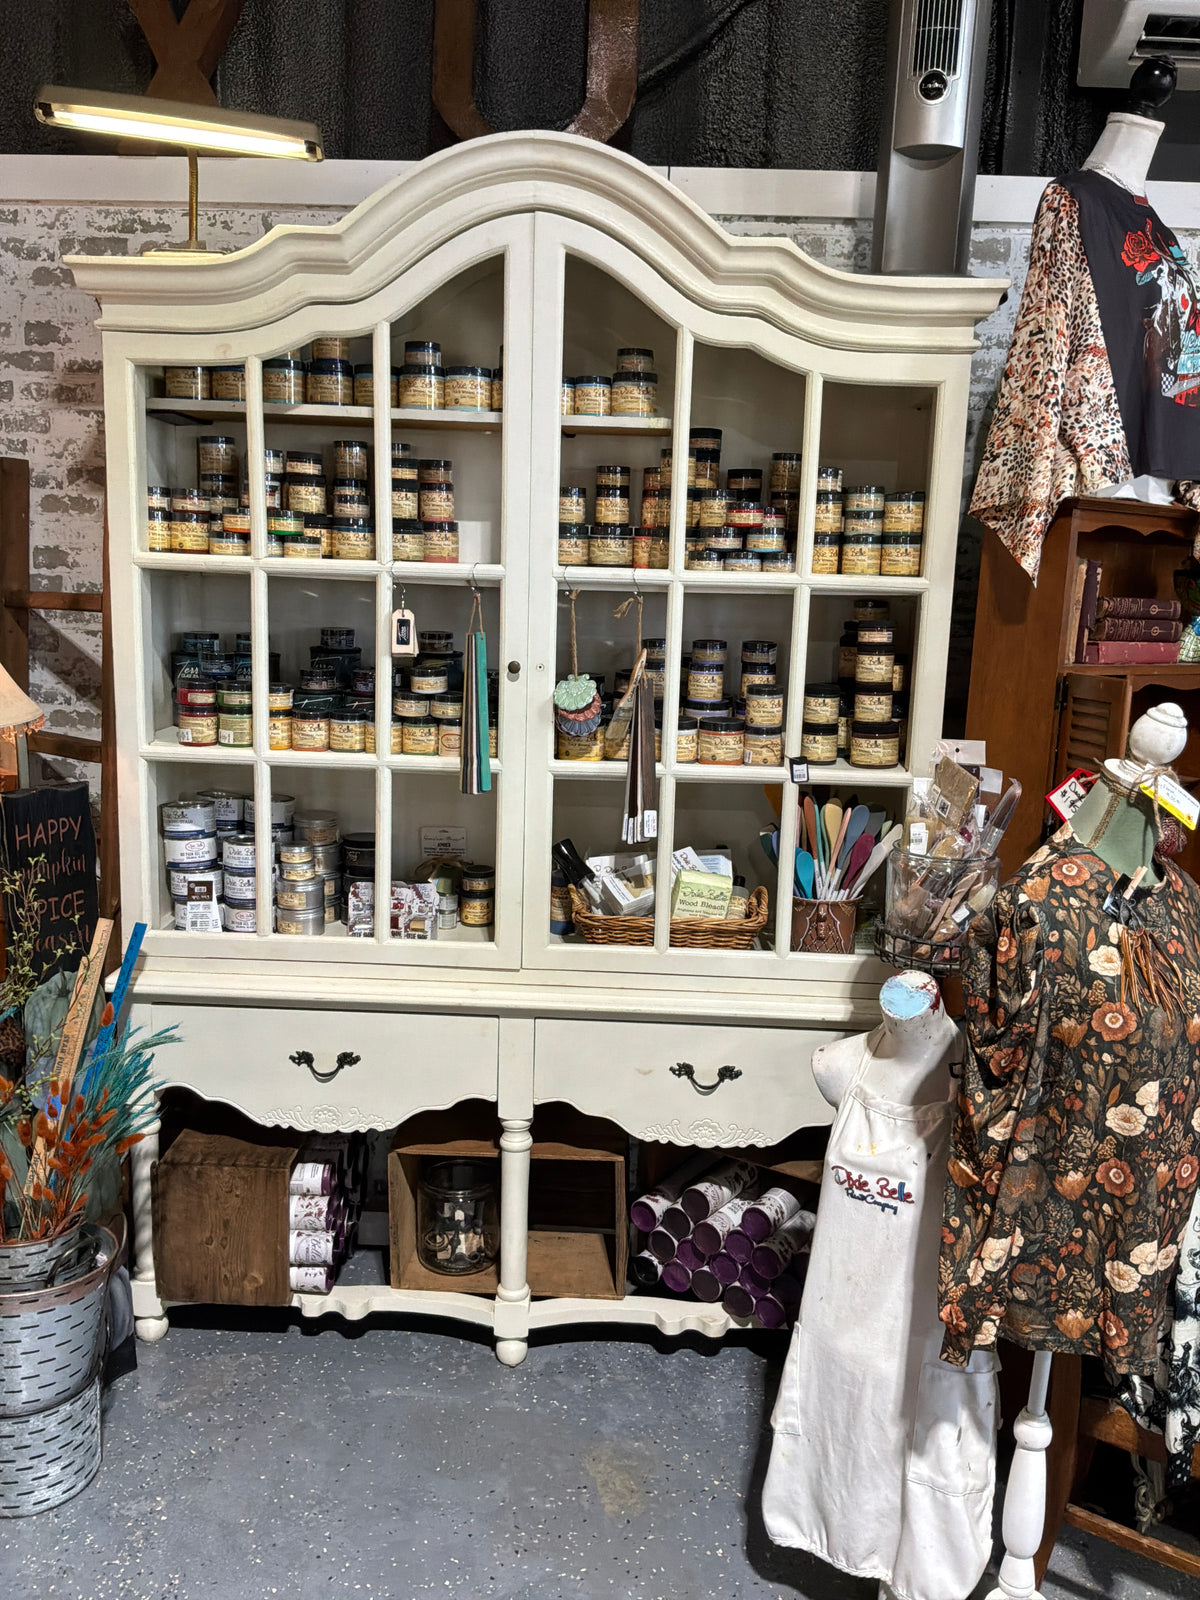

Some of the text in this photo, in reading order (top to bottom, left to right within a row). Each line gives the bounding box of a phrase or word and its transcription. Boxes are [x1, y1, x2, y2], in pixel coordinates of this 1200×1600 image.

[14, 815, 82, 851] HAPPY
[679, 898, 726, 911] Wood Bleach
[831, 1165, 915, 1204] Dixie Belle
